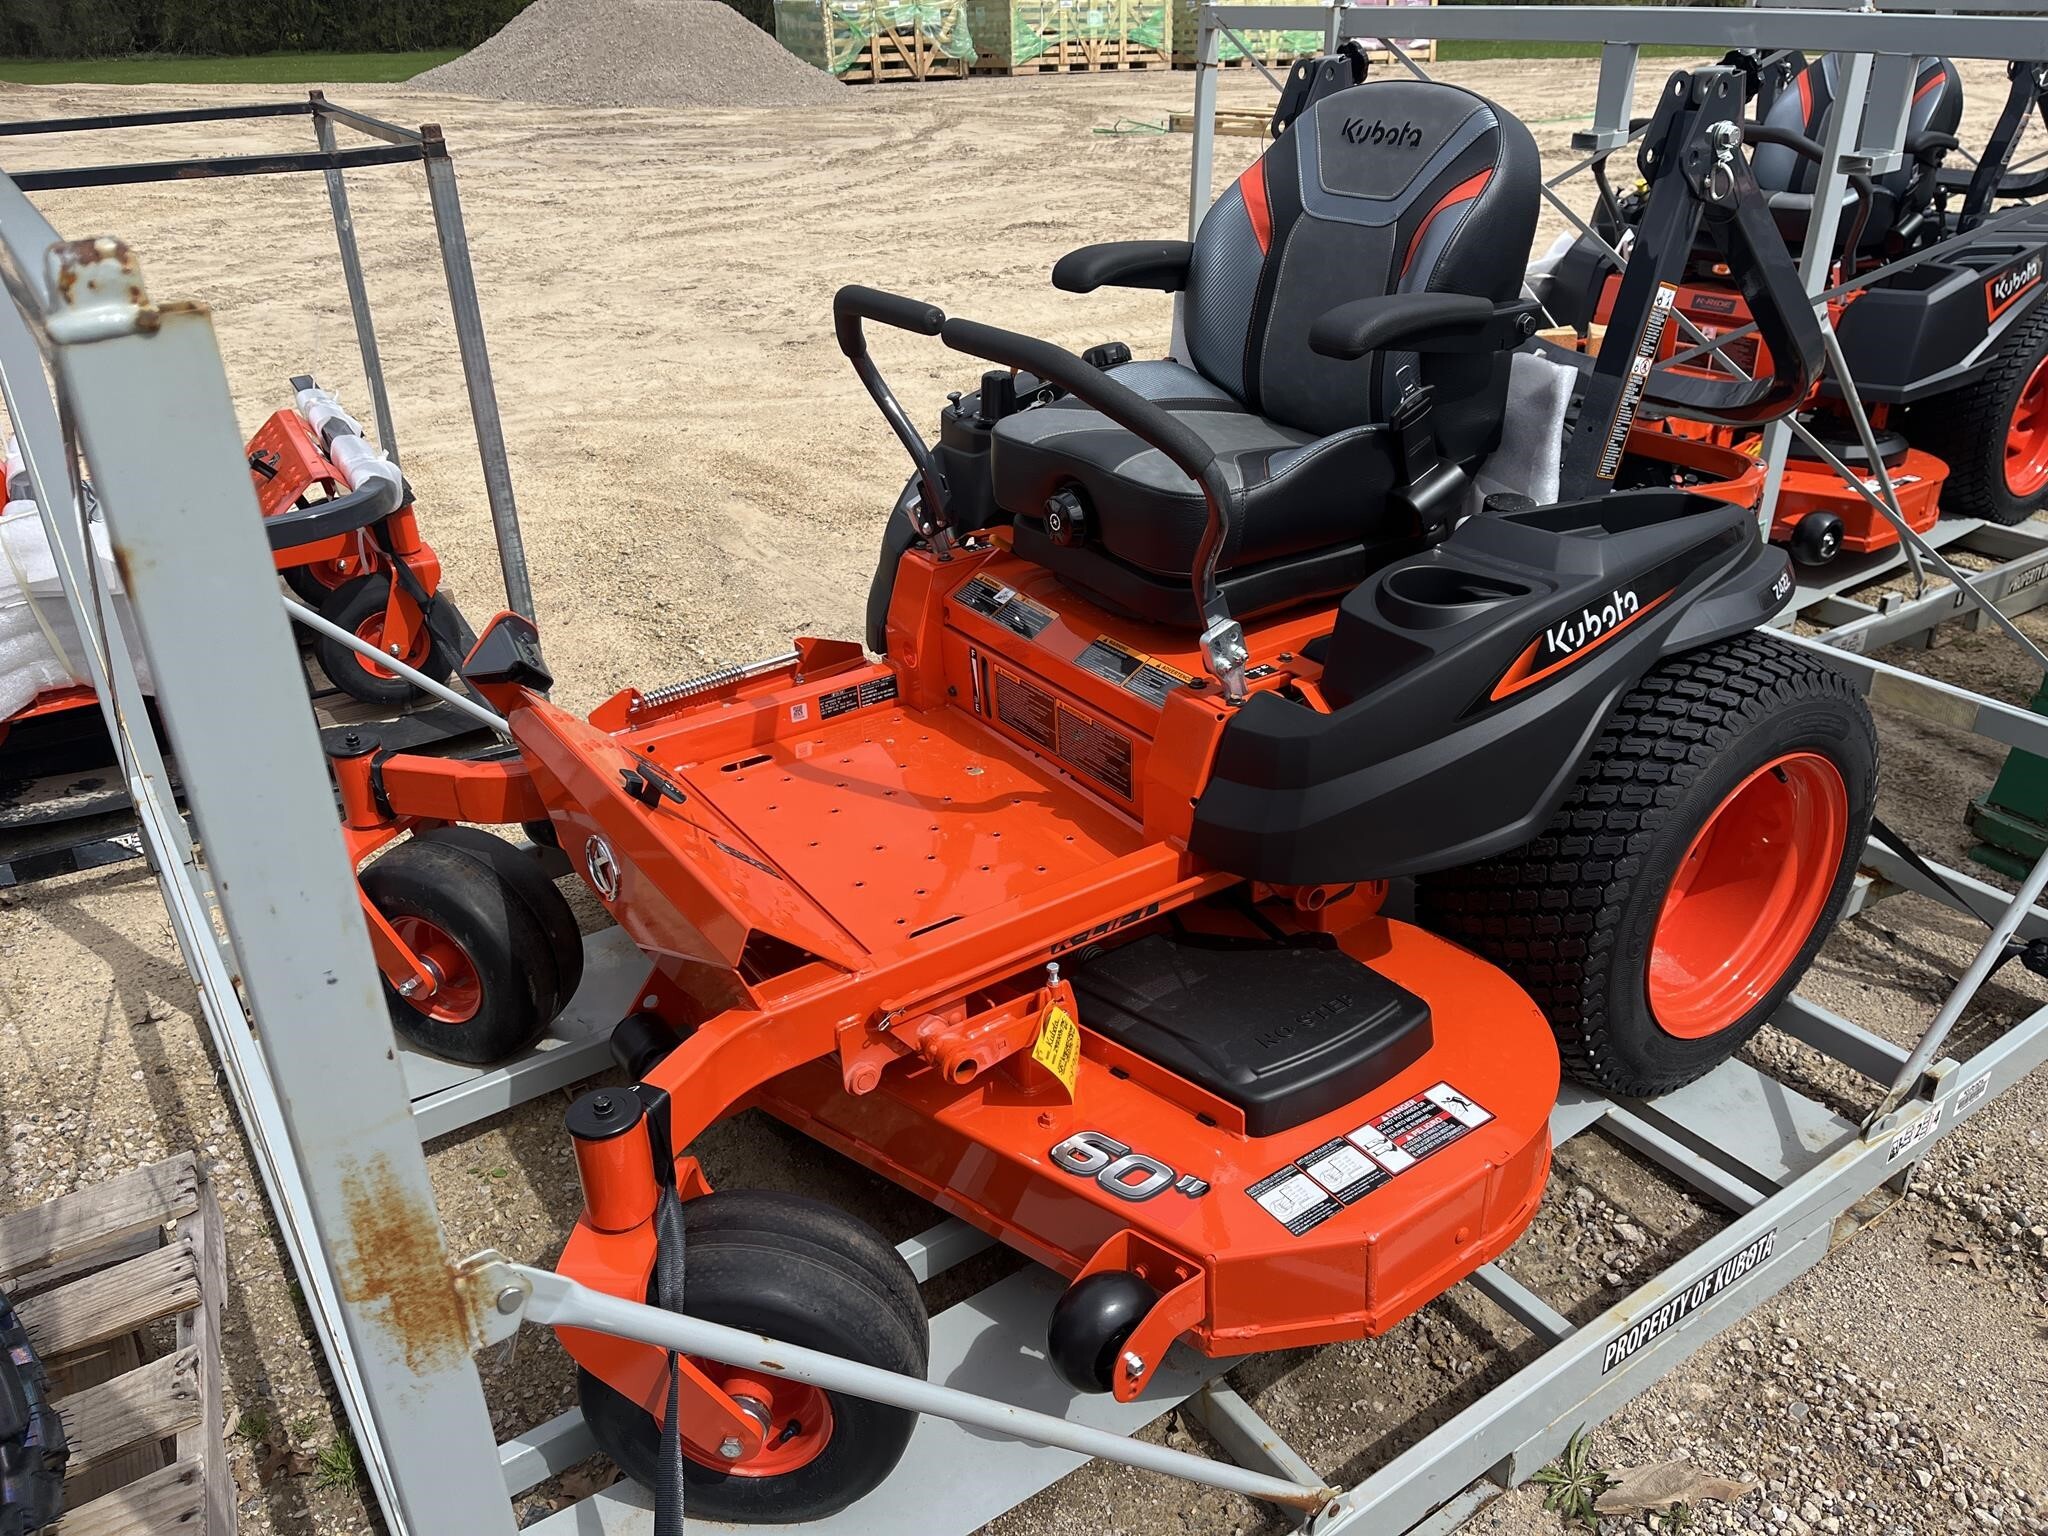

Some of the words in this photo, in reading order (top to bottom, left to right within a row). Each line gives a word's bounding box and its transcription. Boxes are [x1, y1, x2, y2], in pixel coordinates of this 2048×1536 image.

[1341, 117, 1422, 147] Kubota
[1994, 262, 2037, 299] Kubota
[1546, 590, 1639, 653] Kubota
[1161, 664, 1192, 681] ADVERTENC
[1254, 1026, 1295, 1049] NO
[1296, 993, 1353, 1029] STEP
[1376, 1123, 1386, 1131] DO
[1384, 1118, 1395, 1126] NOT
[1393, 1113, 1404, 1121] PUT
[1402, 1105, 1419, 1115] HANDS
[1382, 1125, 1396, 1135] FEET
[1404, 1110, 1423, 1122] MOWER
[1386, 1099, 1417, 1118] DANGER
[1411, 1116, 1443, 1136] PELIGRO
[1603, 1290, 1691, 1373] PROPERTY
[1690, 1273, 1714, 1309] OF
[1712, 1231, 1777, 1295] KUBOTA
